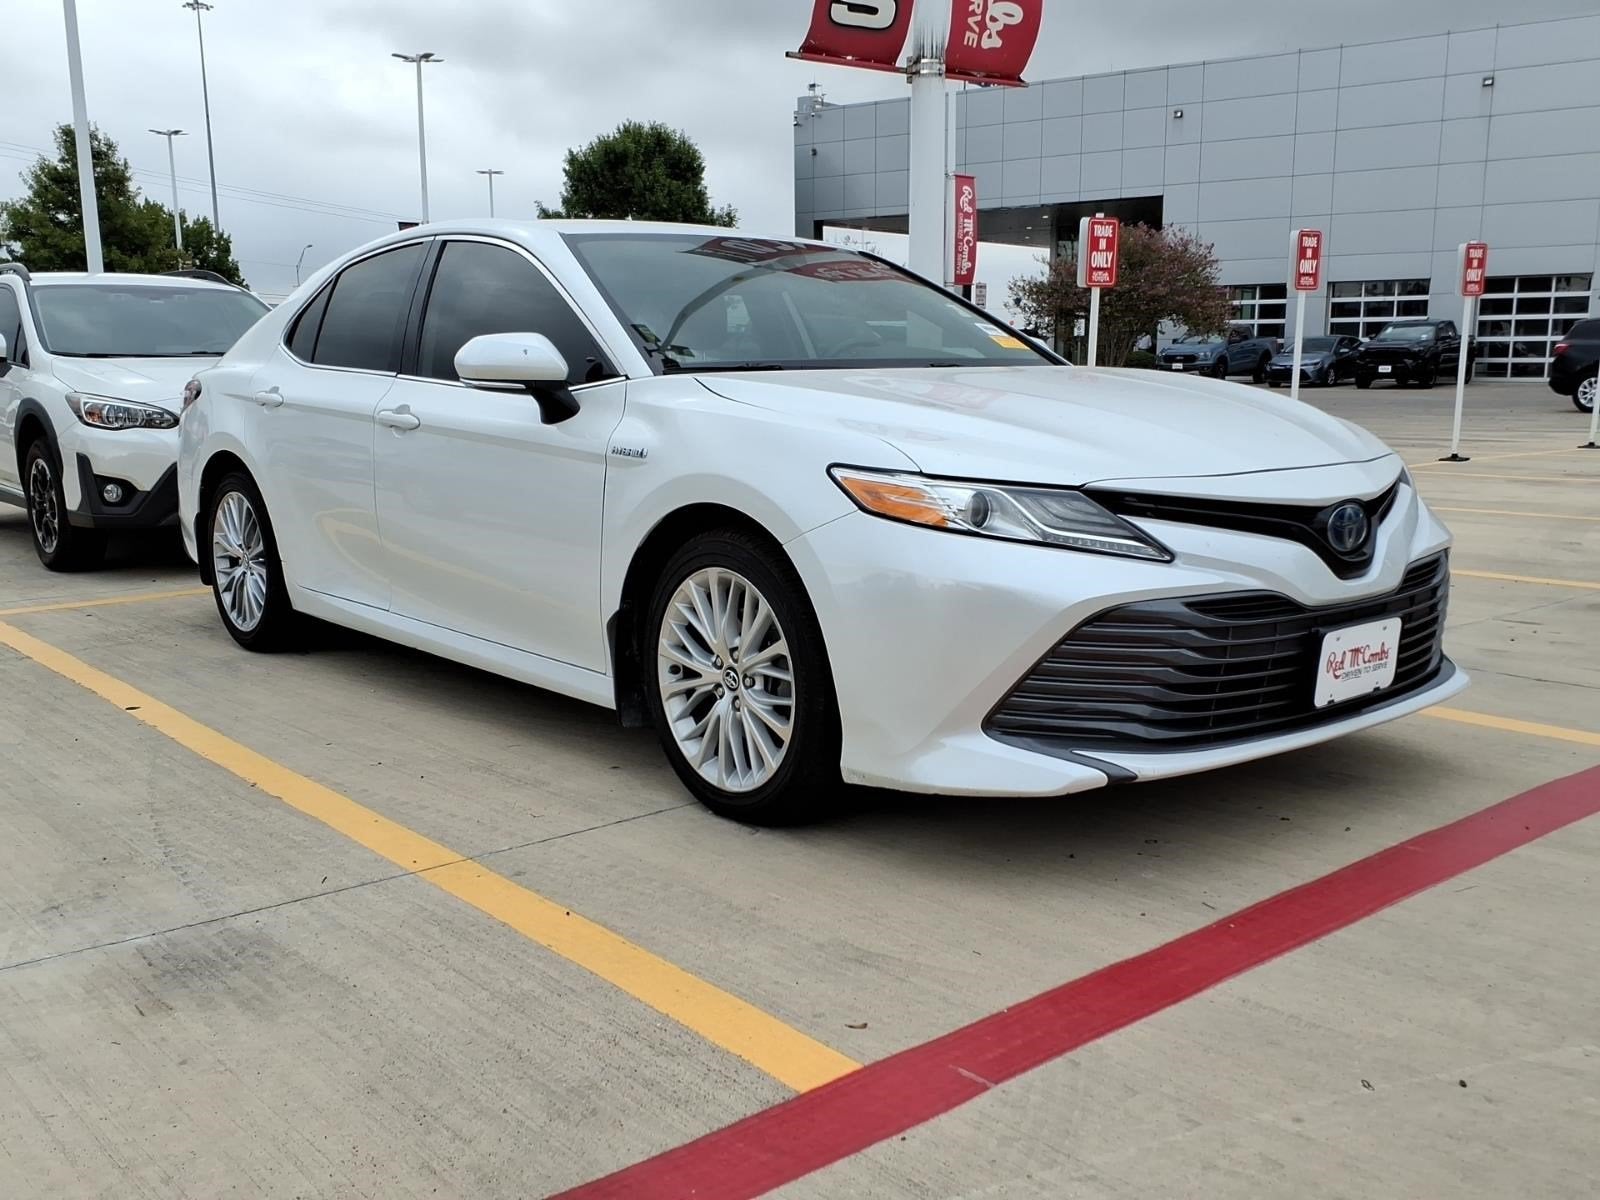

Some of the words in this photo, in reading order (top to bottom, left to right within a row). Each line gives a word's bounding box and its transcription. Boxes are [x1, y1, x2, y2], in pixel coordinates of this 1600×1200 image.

[960, 185, 973, 213] Red
[1094, 225, 1113, 238] TRADE
[961, 215, 974, 275] McCombs
[1099, 238, 1107, 250] IN
[1091, 251, 1113, 268] ONLY
[1299, 259, 1317, 274] ONLY
[1466, 268, 1482, 282] ONLY
[1327, 651, 1347, 680] Red
[1348, 642, 1391, 668] McCombs
